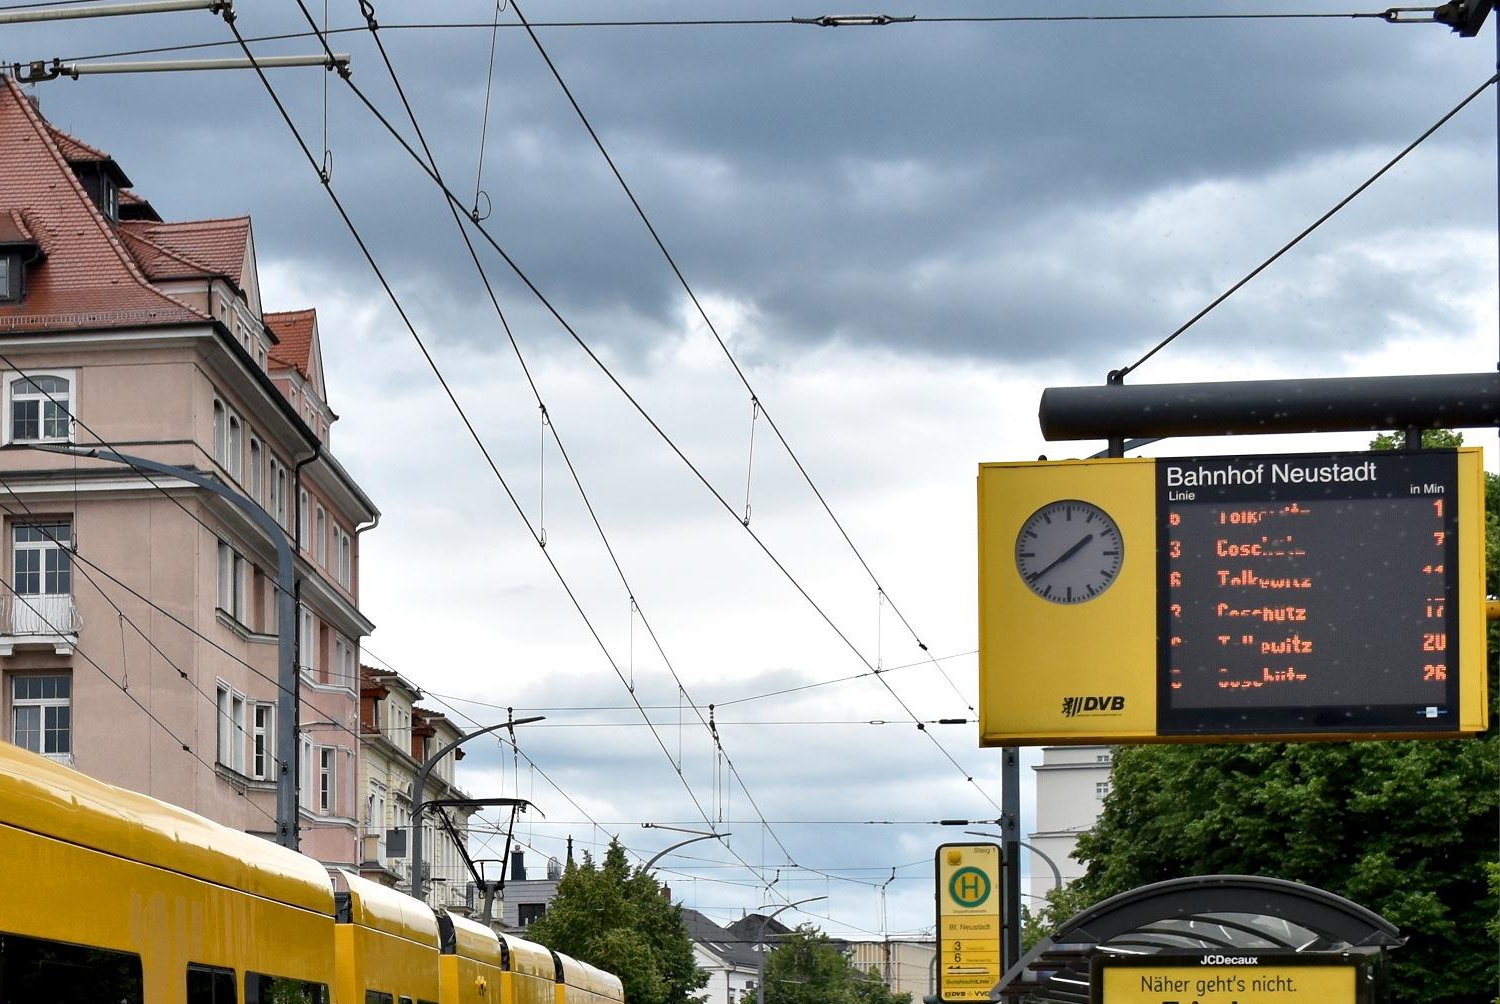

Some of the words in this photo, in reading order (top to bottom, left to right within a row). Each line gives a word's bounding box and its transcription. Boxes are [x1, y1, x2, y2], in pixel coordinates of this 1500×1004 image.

[1166, 465, 1264, 486] Bahnhof
[1271, 462, 1377, 483] Neustadt
[1410, 484, 1421, 494] in
[1423, 483, 1445, 494] Min
[1169, 491, 1196, 501] Linie
[1083, 696, 1125, 711] DVB
[961, 875, 979, 899] H
[960, 922, 991, 931] Neustadt
[954, 940, 962, 951] 3
[954, 952, 962, 963] 6
[1200, 954, 1258, 965] JCDecaux
[1141, 975, 1190, 993] Näher
[1252, 975, 1297, 992] nicht.
